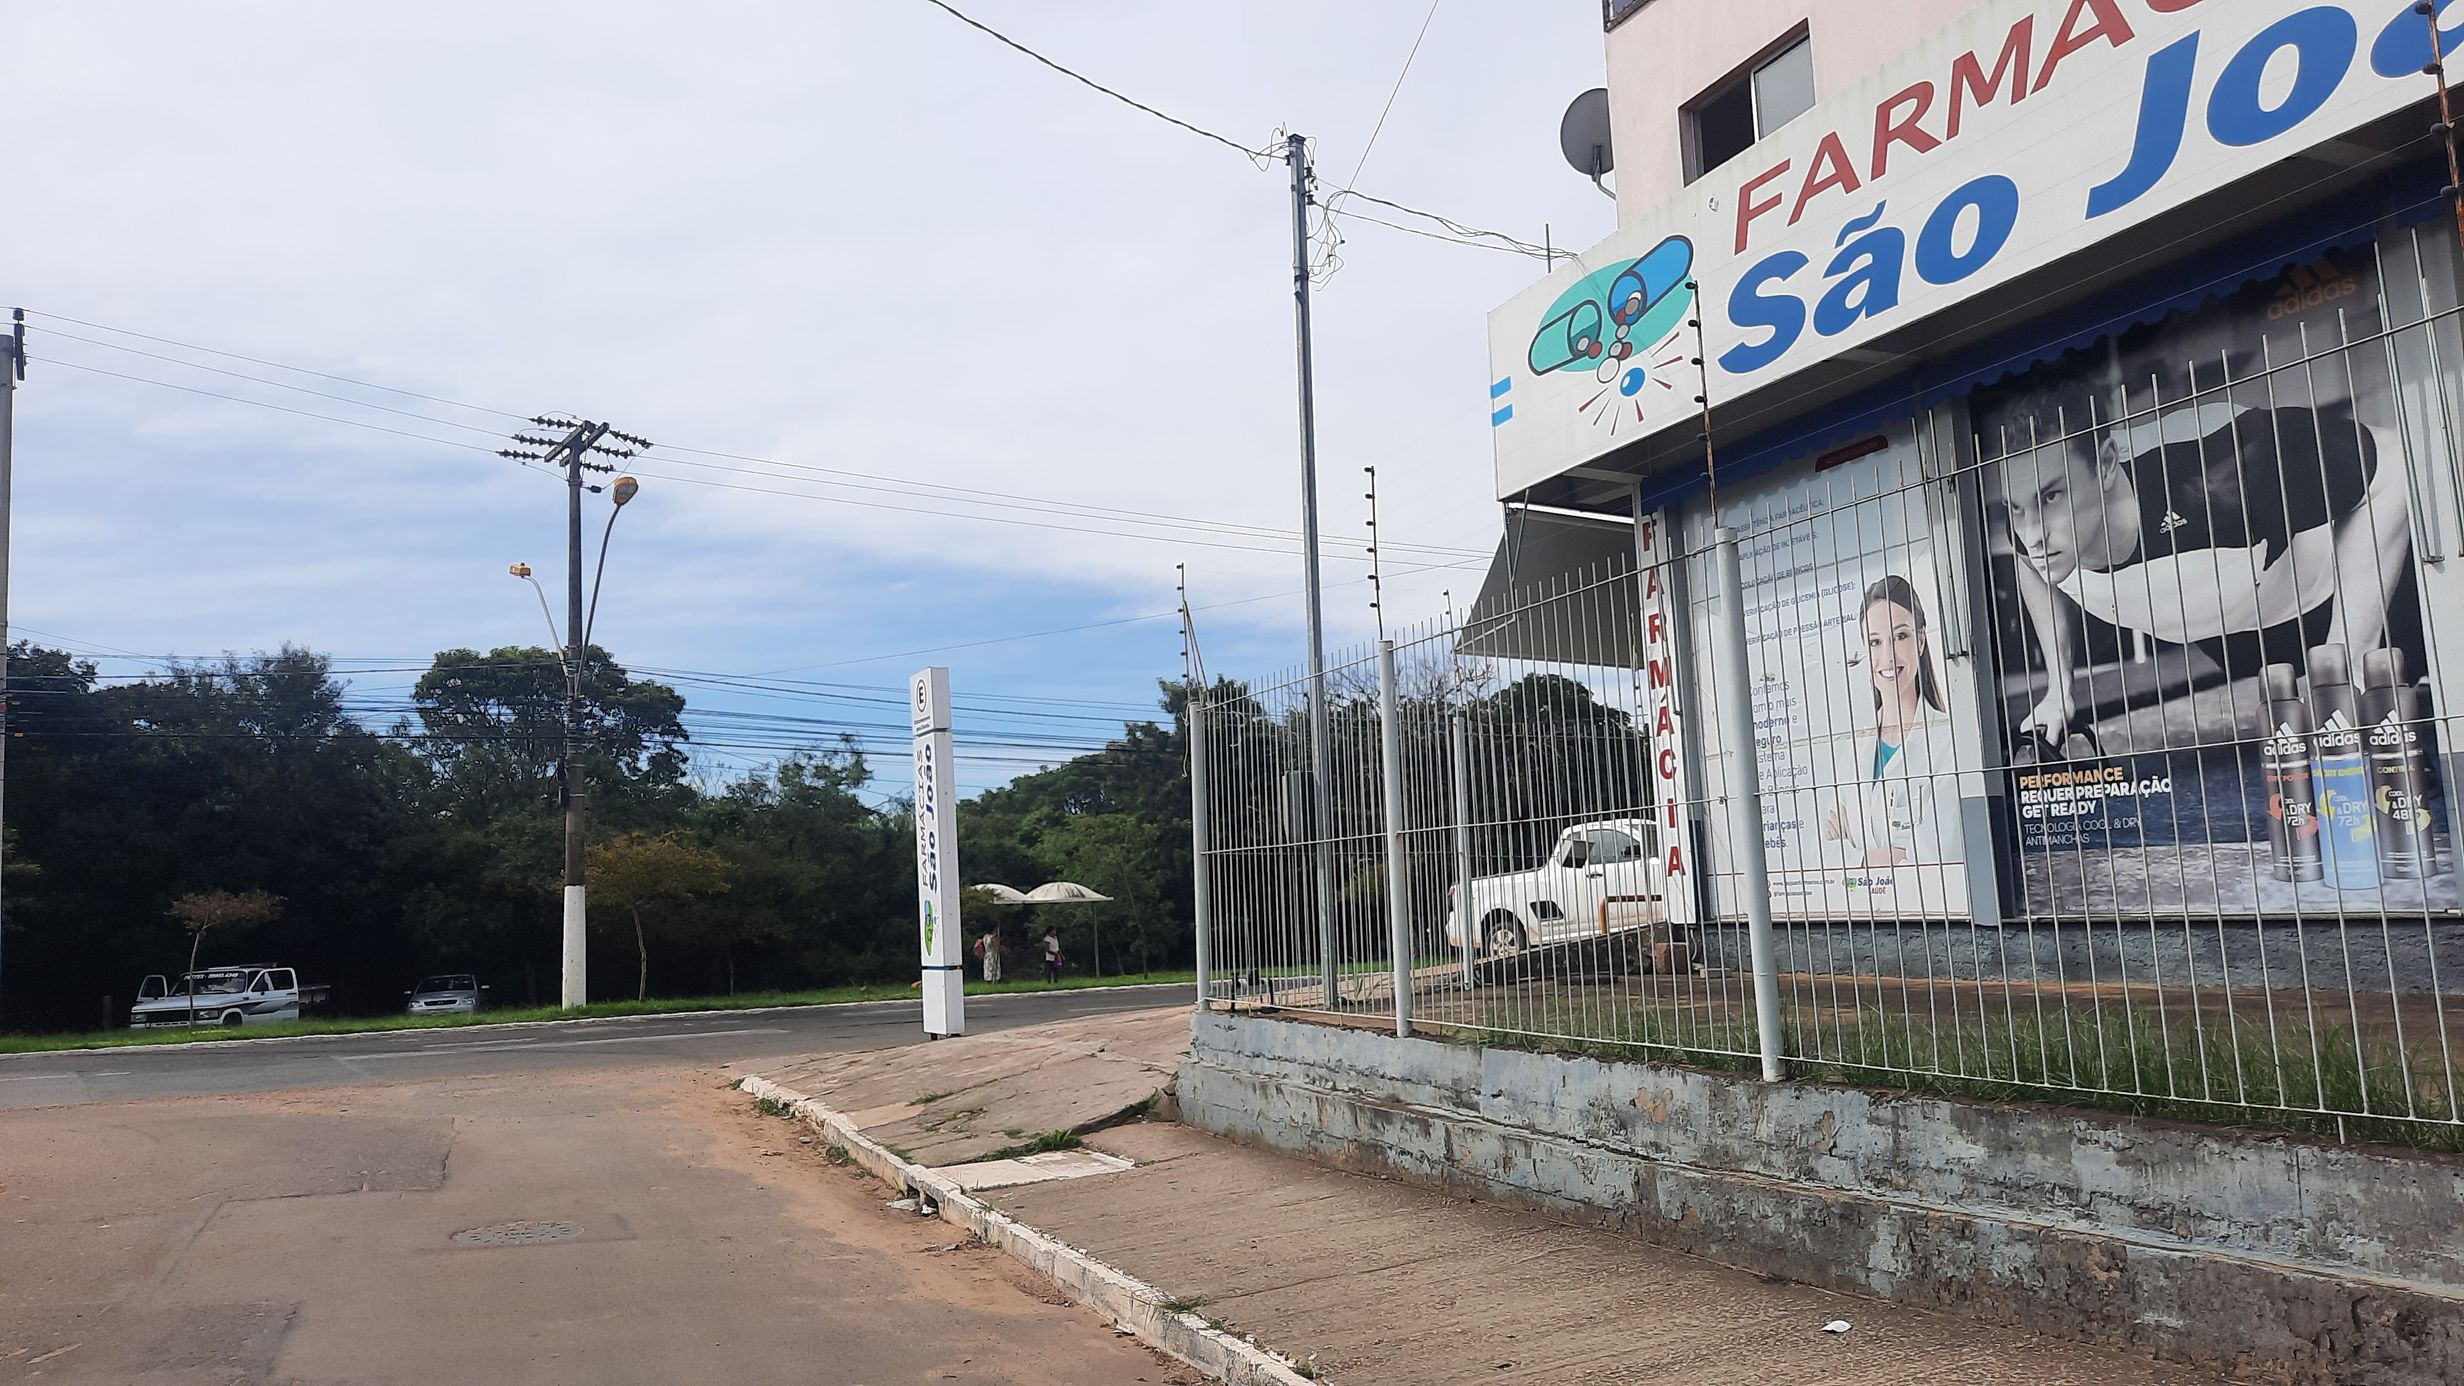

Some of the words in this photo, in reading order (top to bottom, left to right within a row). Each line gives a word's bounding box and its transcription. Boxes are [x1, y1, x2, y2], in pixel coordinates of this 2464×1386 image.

[1734, 0, 2199, 256] FARMA
[1717, 174, 2020, 375] São
[2267, 276, 2356, 321] adidas
[1777, 571, 1785, 580] DE
[1781, 598, 1790, 607] DE
[1784, 628, 1793, 637] DE
[1642, 518, 1687, 877] FARMÁCIA
[1753, 702, 1767, 713] om
[1792, 714, 1797, 723] e
[1755, 735, 1782, 749] eguro
[923, 744, 935, 821] João
[2020, 767, 2124, 789] PERFORMANCE
[2020, 786, 2074, 804] REQUER
[2076, 775, 2172, 800] PREPARAÇÃO
[1762, 804, 1775, 814] ara
[2022, 804, 2049, 819] GET
[2051, 800, 2097, 818] READY
[1763, 819, 1798, 833] rianças
[2114, 817, 2122, 829] &
[1765, 836, 1789, 849] ebês.
[928, 831, 938, 894] São
